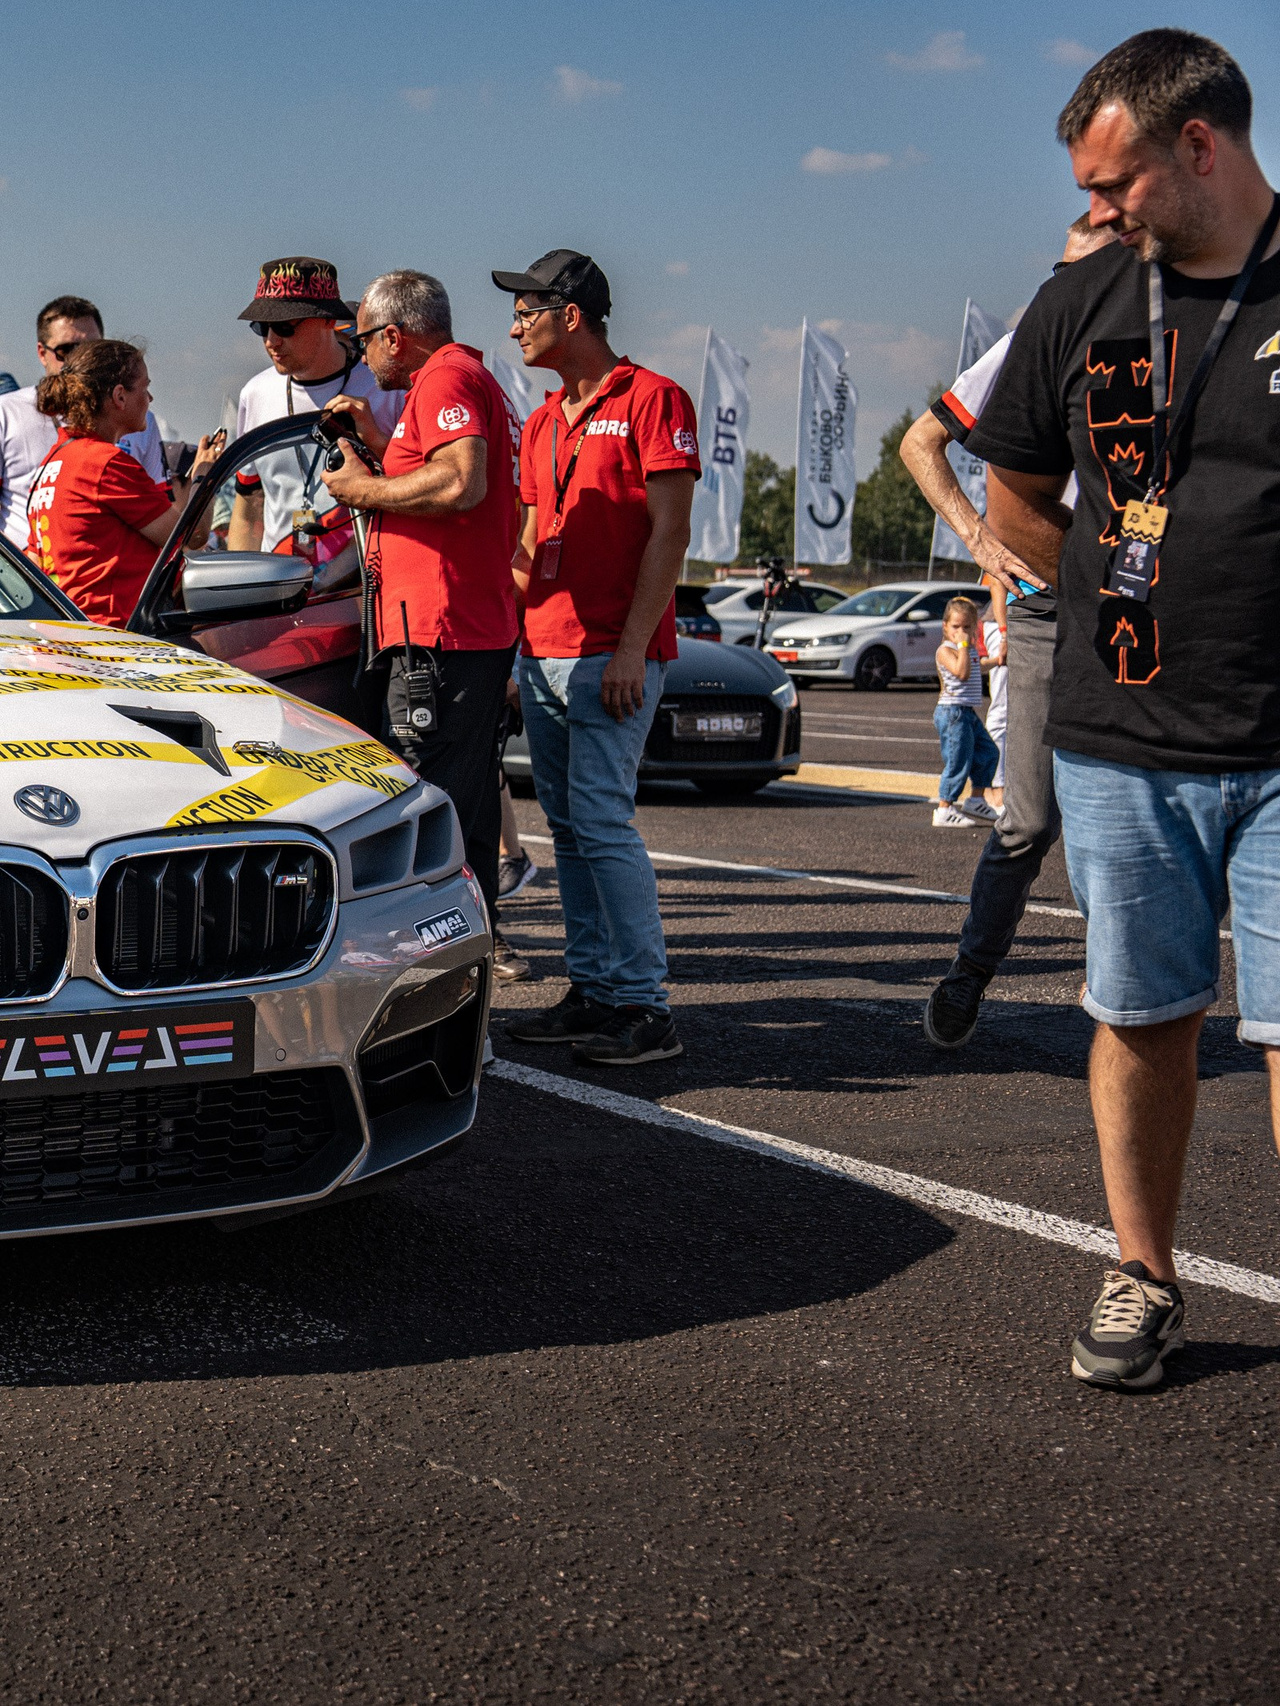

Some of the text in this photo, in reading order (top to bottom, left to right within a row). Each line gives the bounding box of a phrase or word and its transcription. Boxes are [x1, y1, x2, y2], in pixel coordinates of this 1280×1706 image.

[586, 420, 630, 437] RDRC
[712, 407, 737, 466] ВТБ
[818, 409, 833, 484] БЫКОВО
[415, 713, 428, 722] 252
[696, 718, 744, 731] RDRC
[239, 750, 337, 779] UNDER
[420, 913, 468, 947] AIMOL
